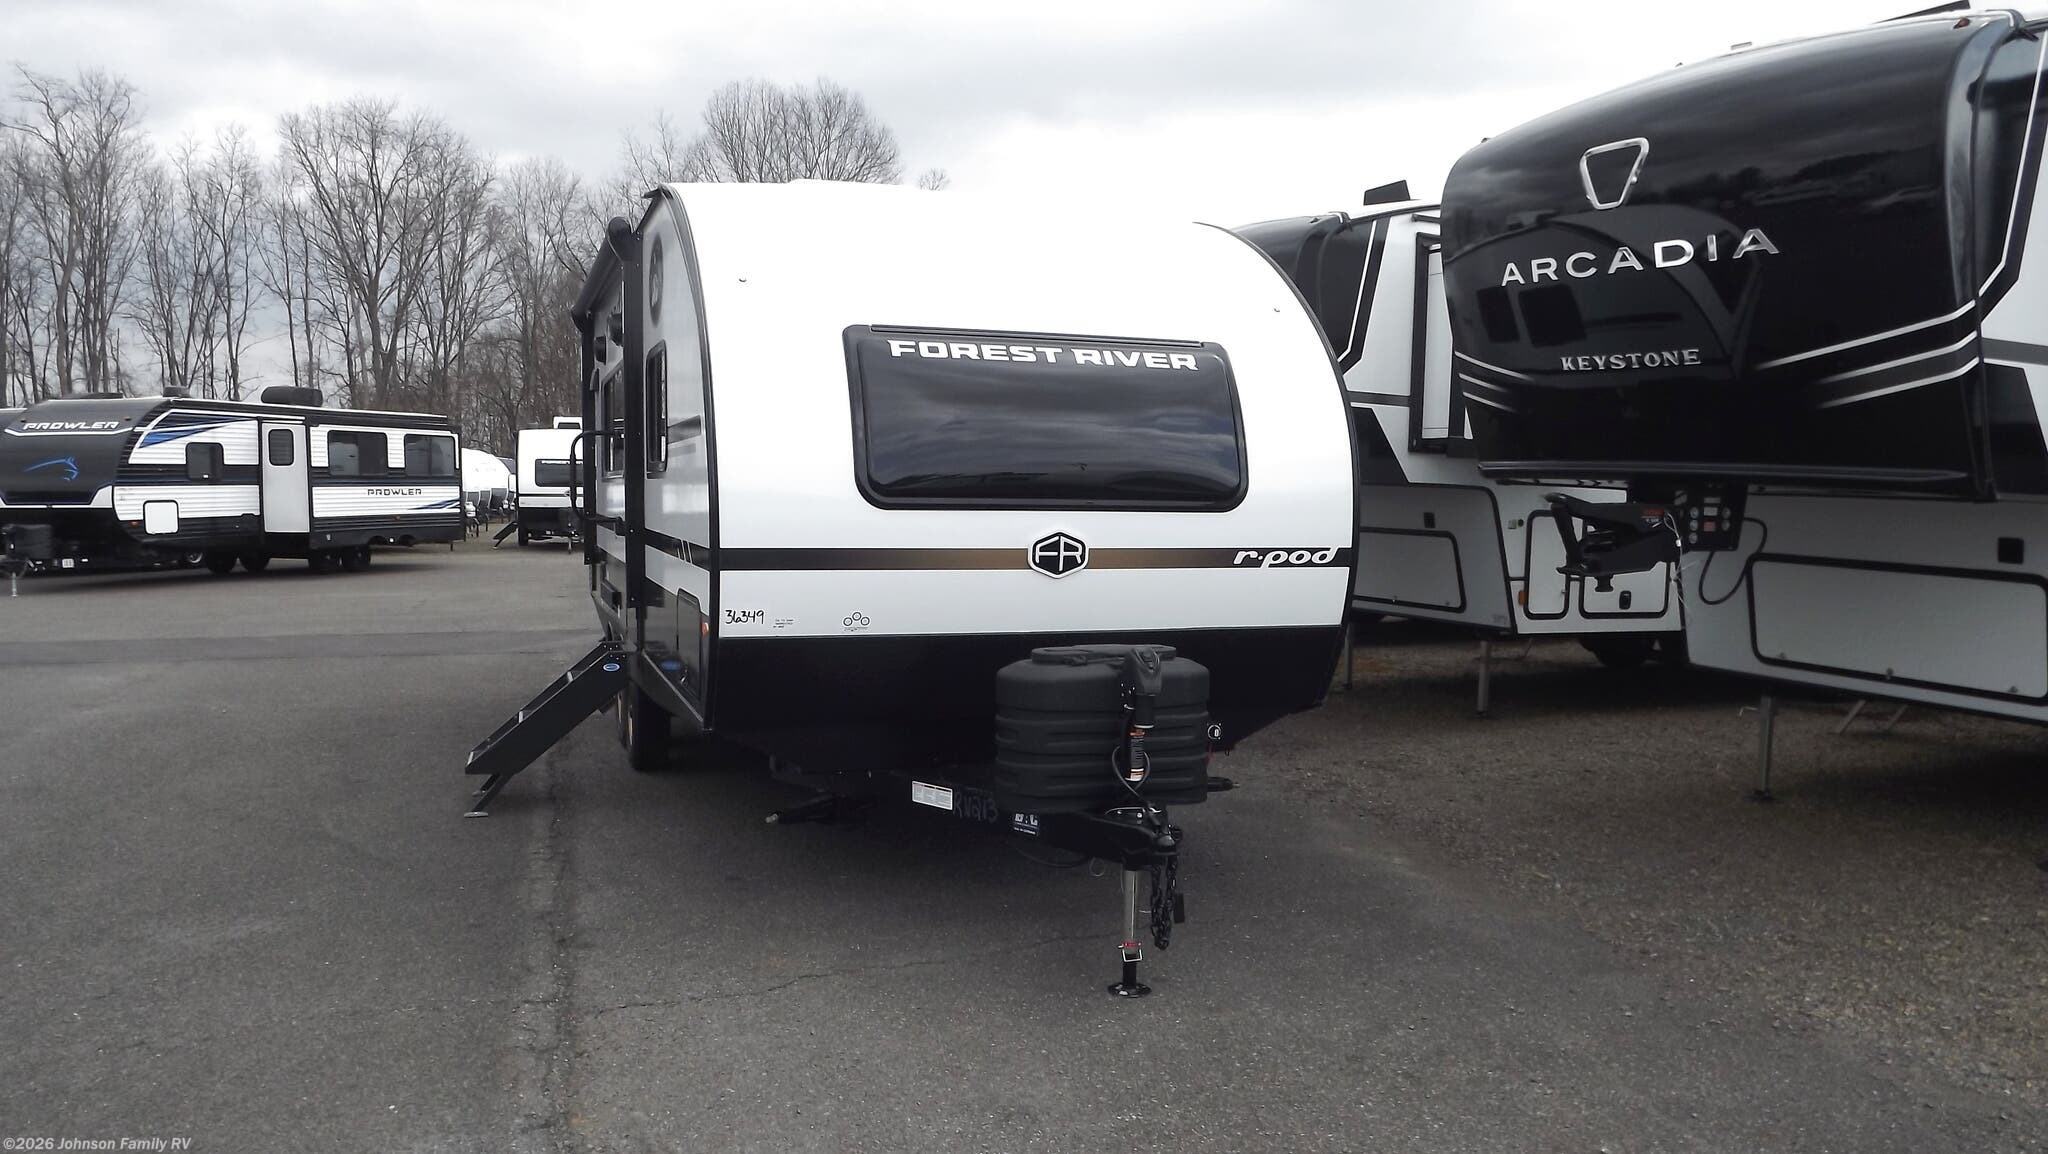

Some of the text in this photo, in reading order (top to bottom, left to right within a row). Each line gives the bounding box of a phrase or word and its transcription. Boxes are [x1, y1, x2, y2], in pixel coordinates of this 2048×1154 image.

[1501, 228, 1780, 287] ARCADIA
[887, 339, 1199, 371] FOREST RIVER
[1560, 349, 1702, 371] KEYSTONE
[22, 421, 120, 431] PROWLER
[367, 488, 422, 496] PROWLER
[725, 609, 765, 625] 36349
